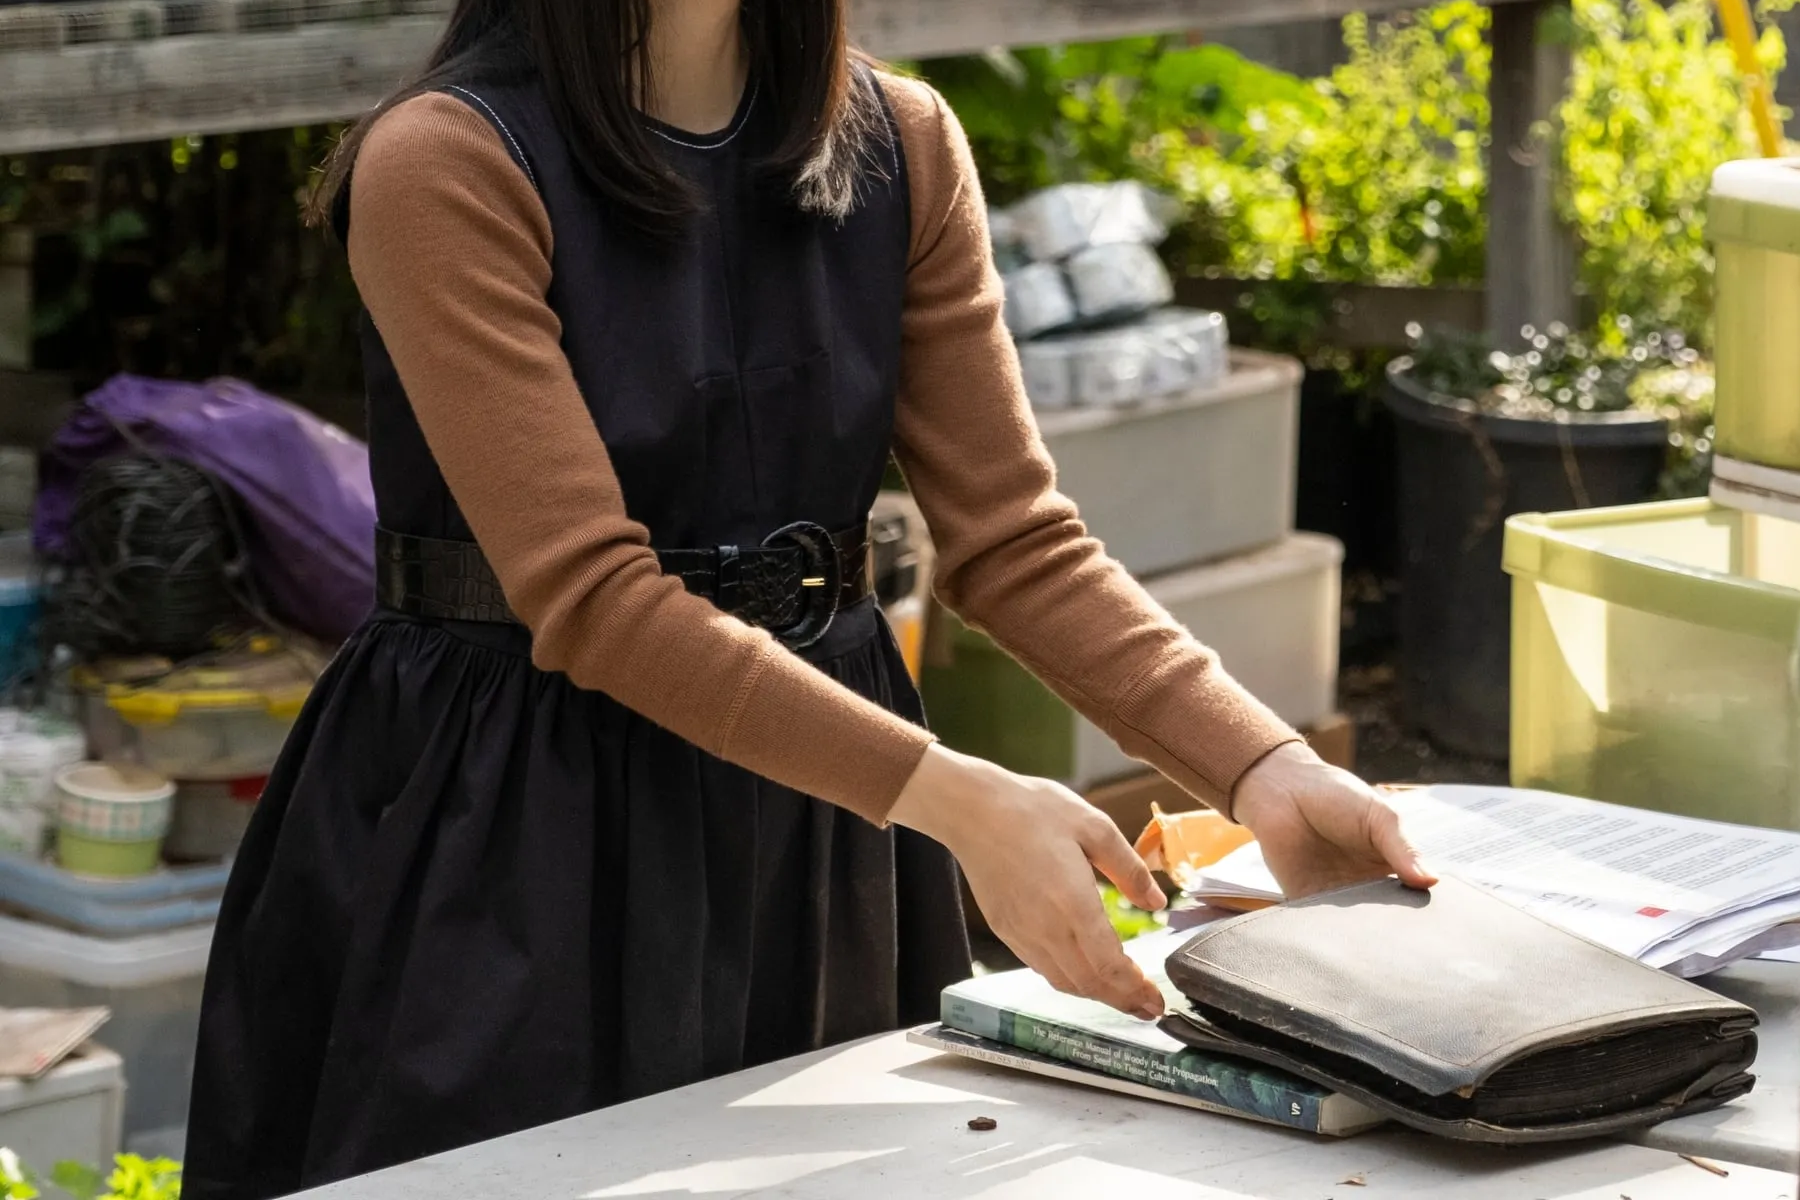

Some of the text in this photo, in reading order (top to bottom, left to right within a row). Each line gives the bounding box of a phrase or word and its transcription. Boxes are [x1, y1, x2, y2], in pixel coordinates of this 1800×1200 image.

[1033, 1025, 1046, 1038] The
[1048, 1030, 1084, 1047] Reference
[1085, 1040, 1112, 1055] Manual
[1113, 1049, 1121, 1059] of
[1123, 1050, 1149, 1068] Woody
[1151, 1059, 1170, 1073] Plant
[1072, 1048, 1176, 1086] From Seed to Tissue Culture
[1291, 1102, 1302, 1116] VP
